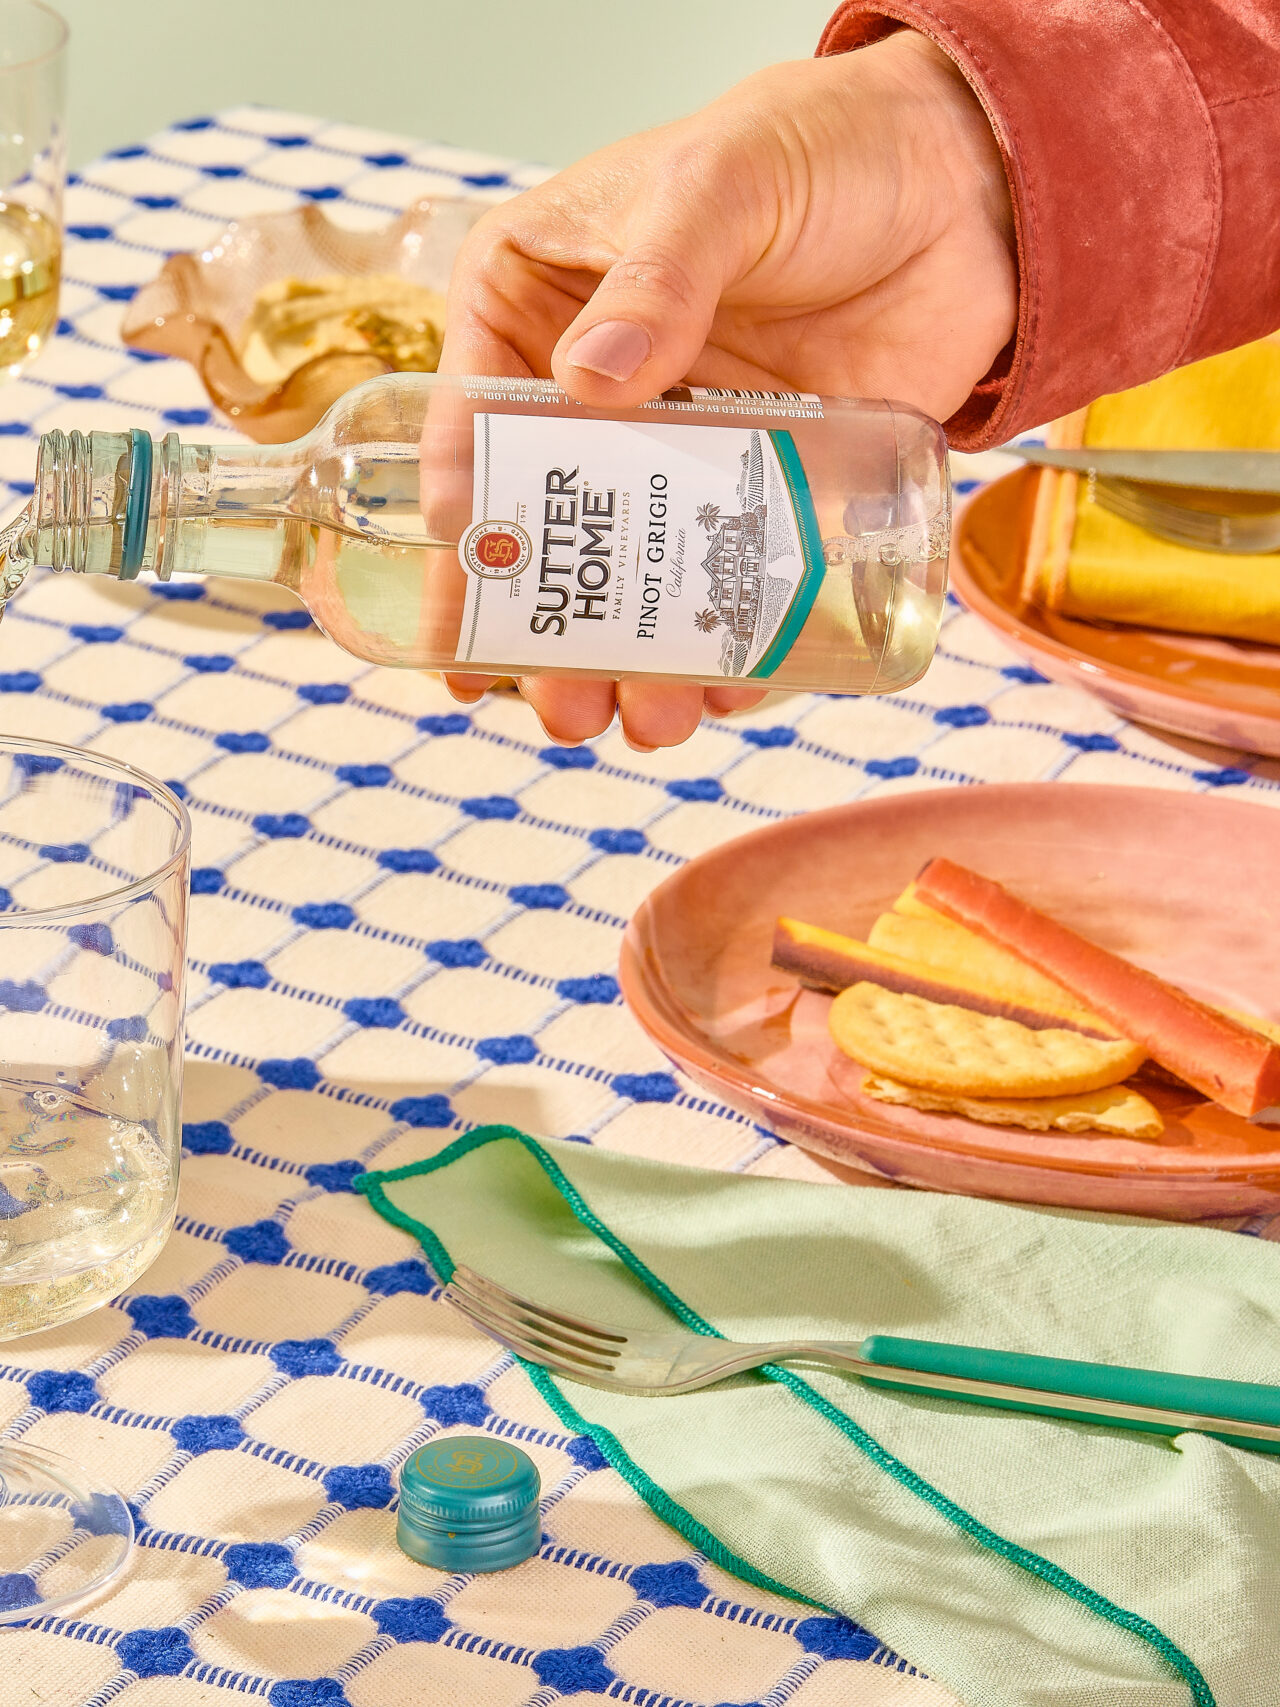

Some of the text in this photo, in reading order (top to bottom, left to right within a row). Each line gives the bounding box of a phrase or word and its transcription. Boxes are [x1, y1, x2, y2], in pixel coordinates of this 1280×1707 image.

[464, 391, 478, 399] CA
[480, 391, 506, 400] LODI,
[509, 393, 530, 402] AND
[533, 395, 559, 404] NAPA
[669, 402, 705, 412] SUTTER
[735, 398, 824, 409] SUTTERHOME.COM
[706, 405, 720, 413] BY
[721, 406, 764, 416] BOTTLED
[766, 408, 786, 417] AND
[788, 409, 825, 419] VINTED
[507, 529, 527, 573] FAMILY OWNED
[529, 465, 579, 637] SUTTER
[572, 487, 616, 621] HOME
[612, 491, 630, 620] FAMILY VINEYARDS
[470, 547, 486, 572] SUTTER
[637, 473, 668, 640] PINOT GRIGIO
[665, 527, 688, 598] California
